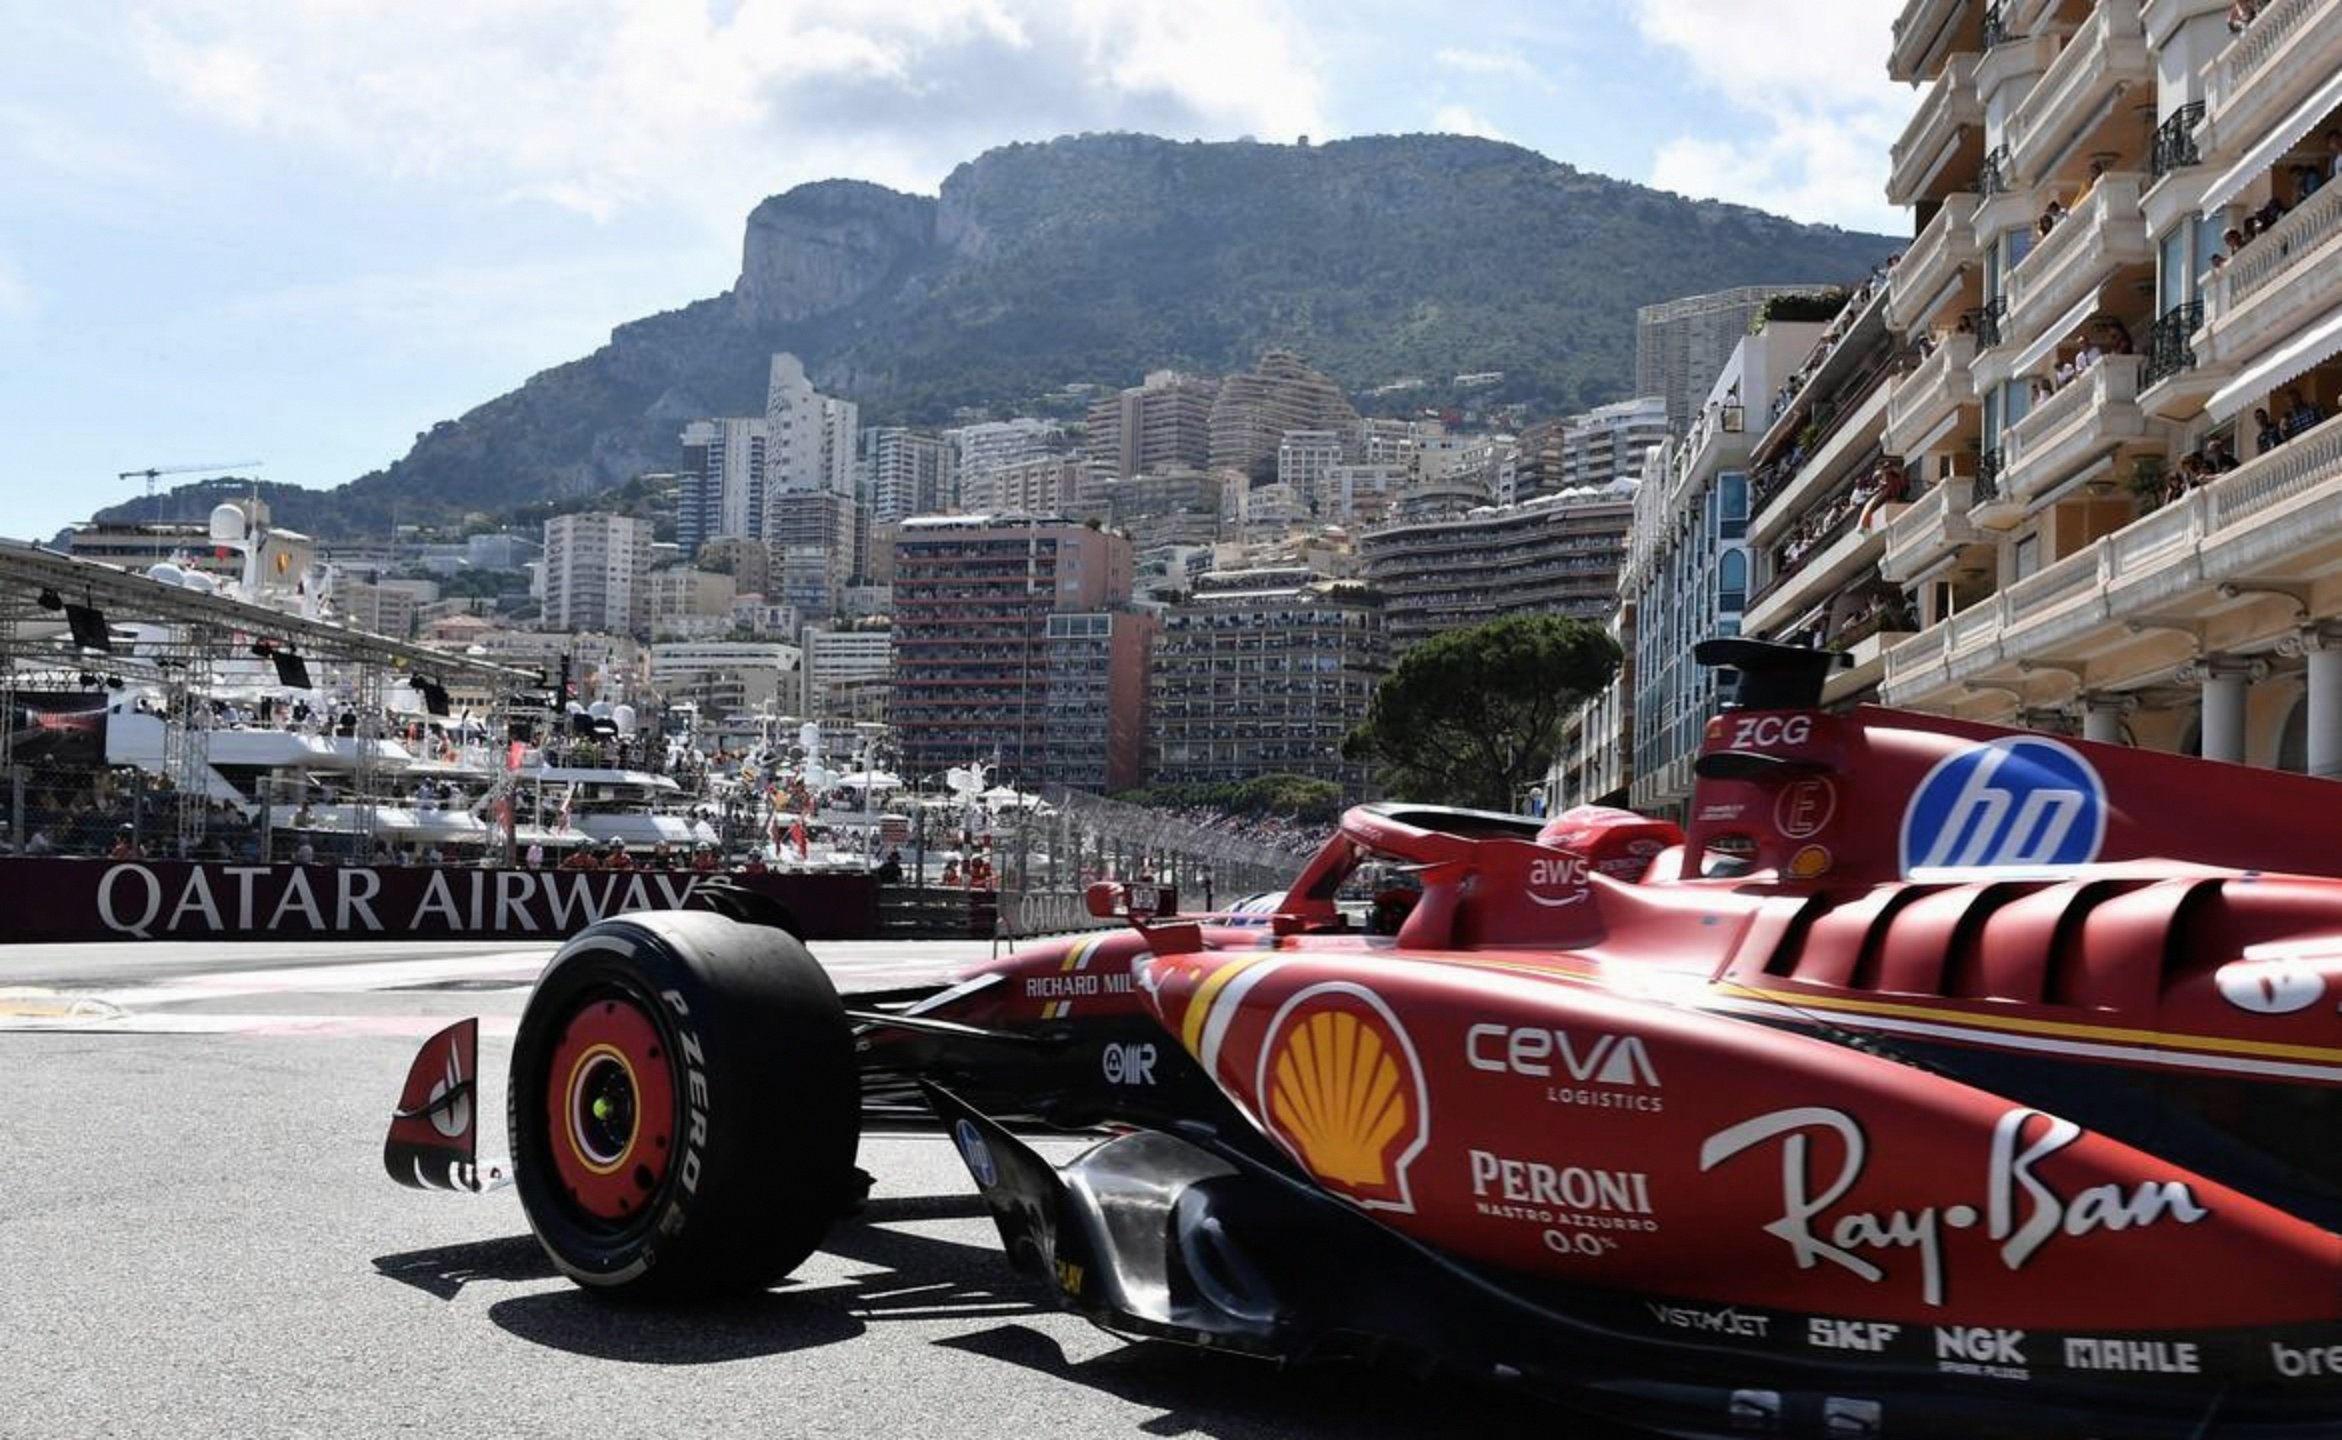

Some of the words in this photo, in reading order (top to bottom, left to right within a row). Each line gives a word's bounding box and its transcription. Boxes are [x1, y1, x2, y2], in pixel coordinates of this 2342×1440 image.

[1730, 716, 1812, 748] ZCG
[1530, 858, 1589, 885] aws
[97, 863, 383, 938] QATAR
[410, 870, 733, 931] AIRWAY
[1020, 895, 1072, 931] QATAR
[1026, 976, 1098, 997] RICHARD
[1103, 973, 1136, 993] MIL
[661, 989, 690, 1016] P
[681, 1031, 710, 1194] ZERO
[1548, 1087, 1664, 1112] LOGISTICS
[1468, 1149, 1654, 1213] PERONI
[1476, 1203, 1552, 1224] NASTRO
[1558, 1213, 1659, 1232] AZZURRO
[1808, 1319, 1899, 1351] SKF
[1934, 1325, 2027, 1364] NGK
[2064, 1338, 2200, 1373] MAHLE
[2272, 1343, 2341, 1377] bre
